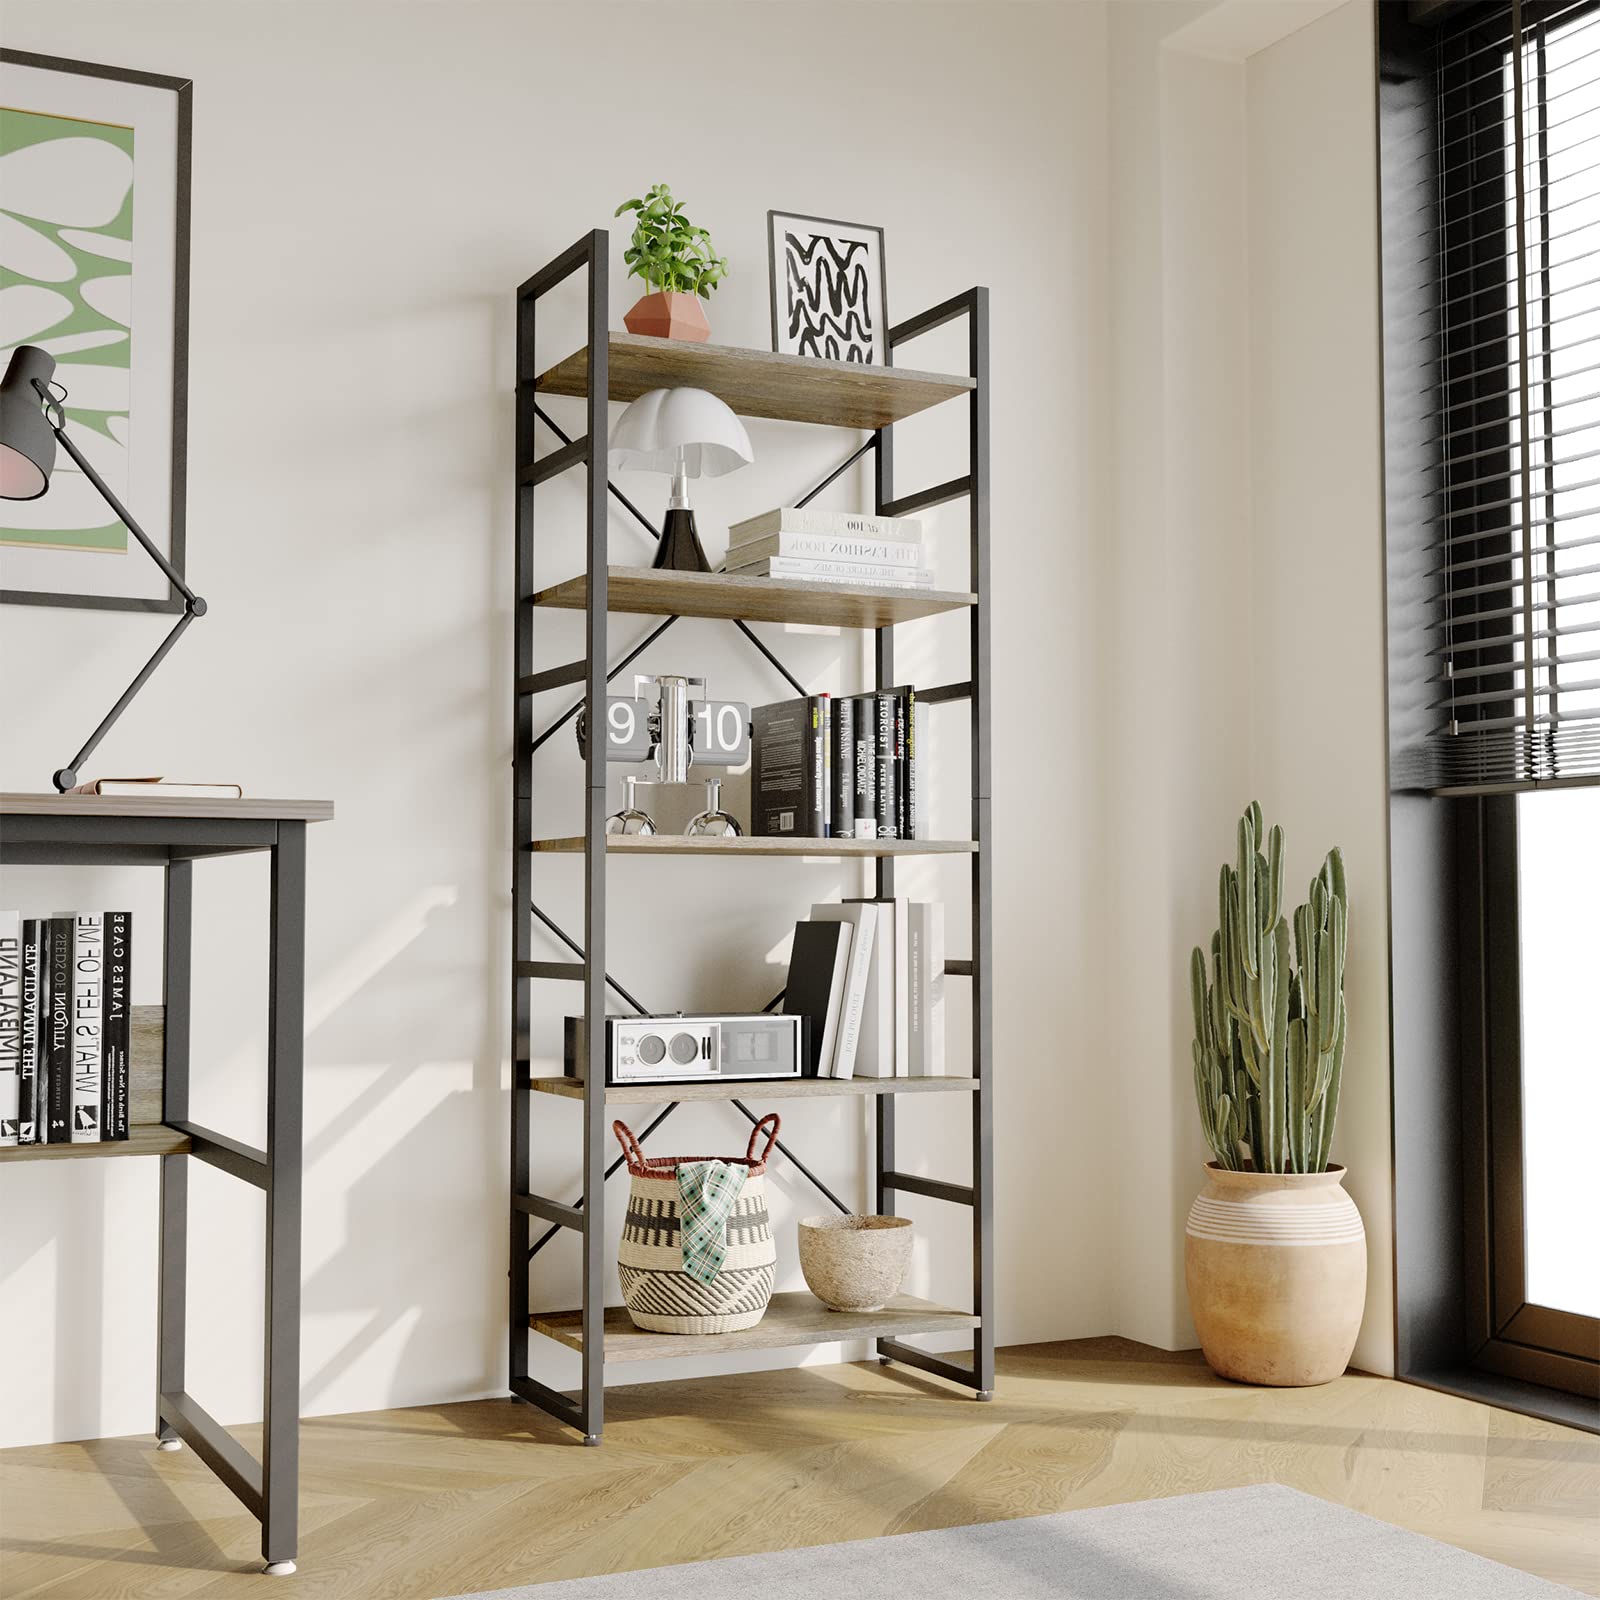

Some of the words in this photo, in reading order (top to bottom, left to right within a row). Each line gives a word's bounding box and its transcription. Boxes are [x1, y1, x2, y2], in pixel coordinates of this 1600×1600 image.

[608, 702, 636, 745] 9
[698, 703, 742, 751] 10
[879, 700, 889, 749] EXORCIST
[814, 736, 823, 753] Spaces
[840, 727, 850, 759] INSANE
[857, 740, 866, 765] MICHAEL
[906, 726, 915, 758] daughter
[814, 760, 823, 779] Security
[868, 771, 876, 781] OF
[814, 789, 823, 812] Insecurity
[868, 786, 876, 801] LION
[22, 943, 37, 1044] IMMACULATE
[849, 992, 860, 1030] PICOULT
[22, 1048, 35, 1080] THE
